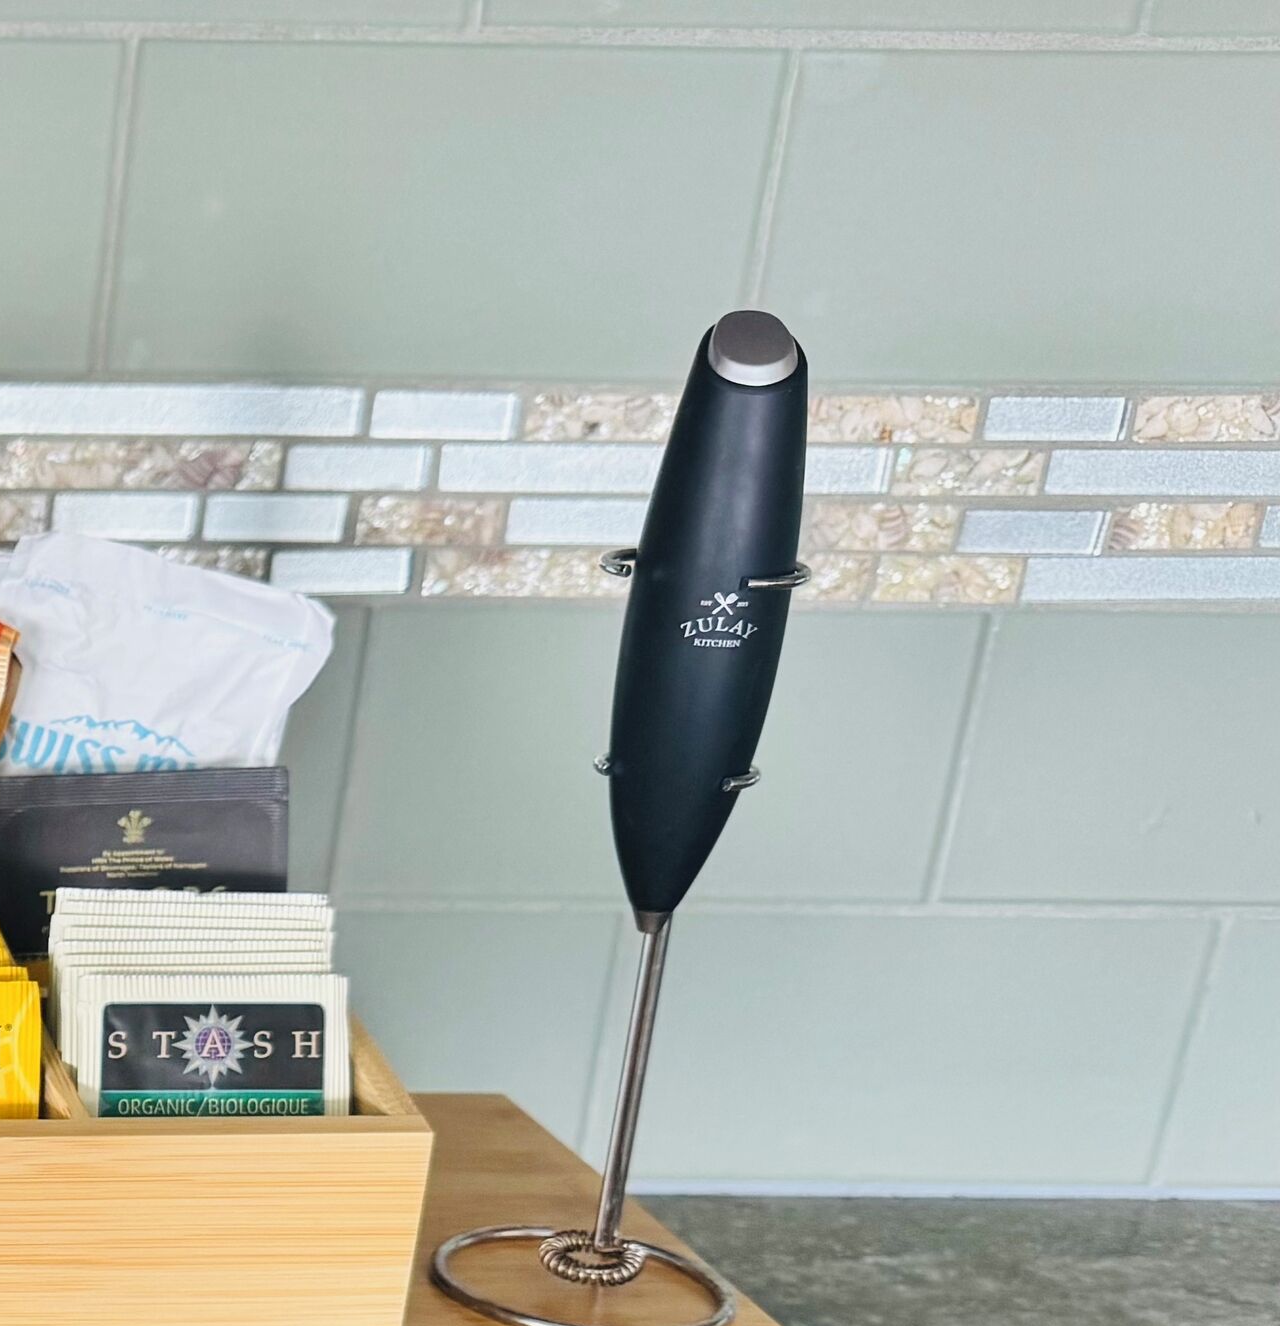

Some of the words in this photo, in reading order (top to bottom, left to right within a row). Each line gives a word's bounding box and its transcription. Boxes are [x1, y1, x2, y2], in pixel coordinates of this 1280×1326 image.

[680, 616, 758, 639] ZULAY
[693, 638, 741, 648] KITCHEN
[118, 1096, 308, 1116] ORGANIC/BIOLOGIQUE
